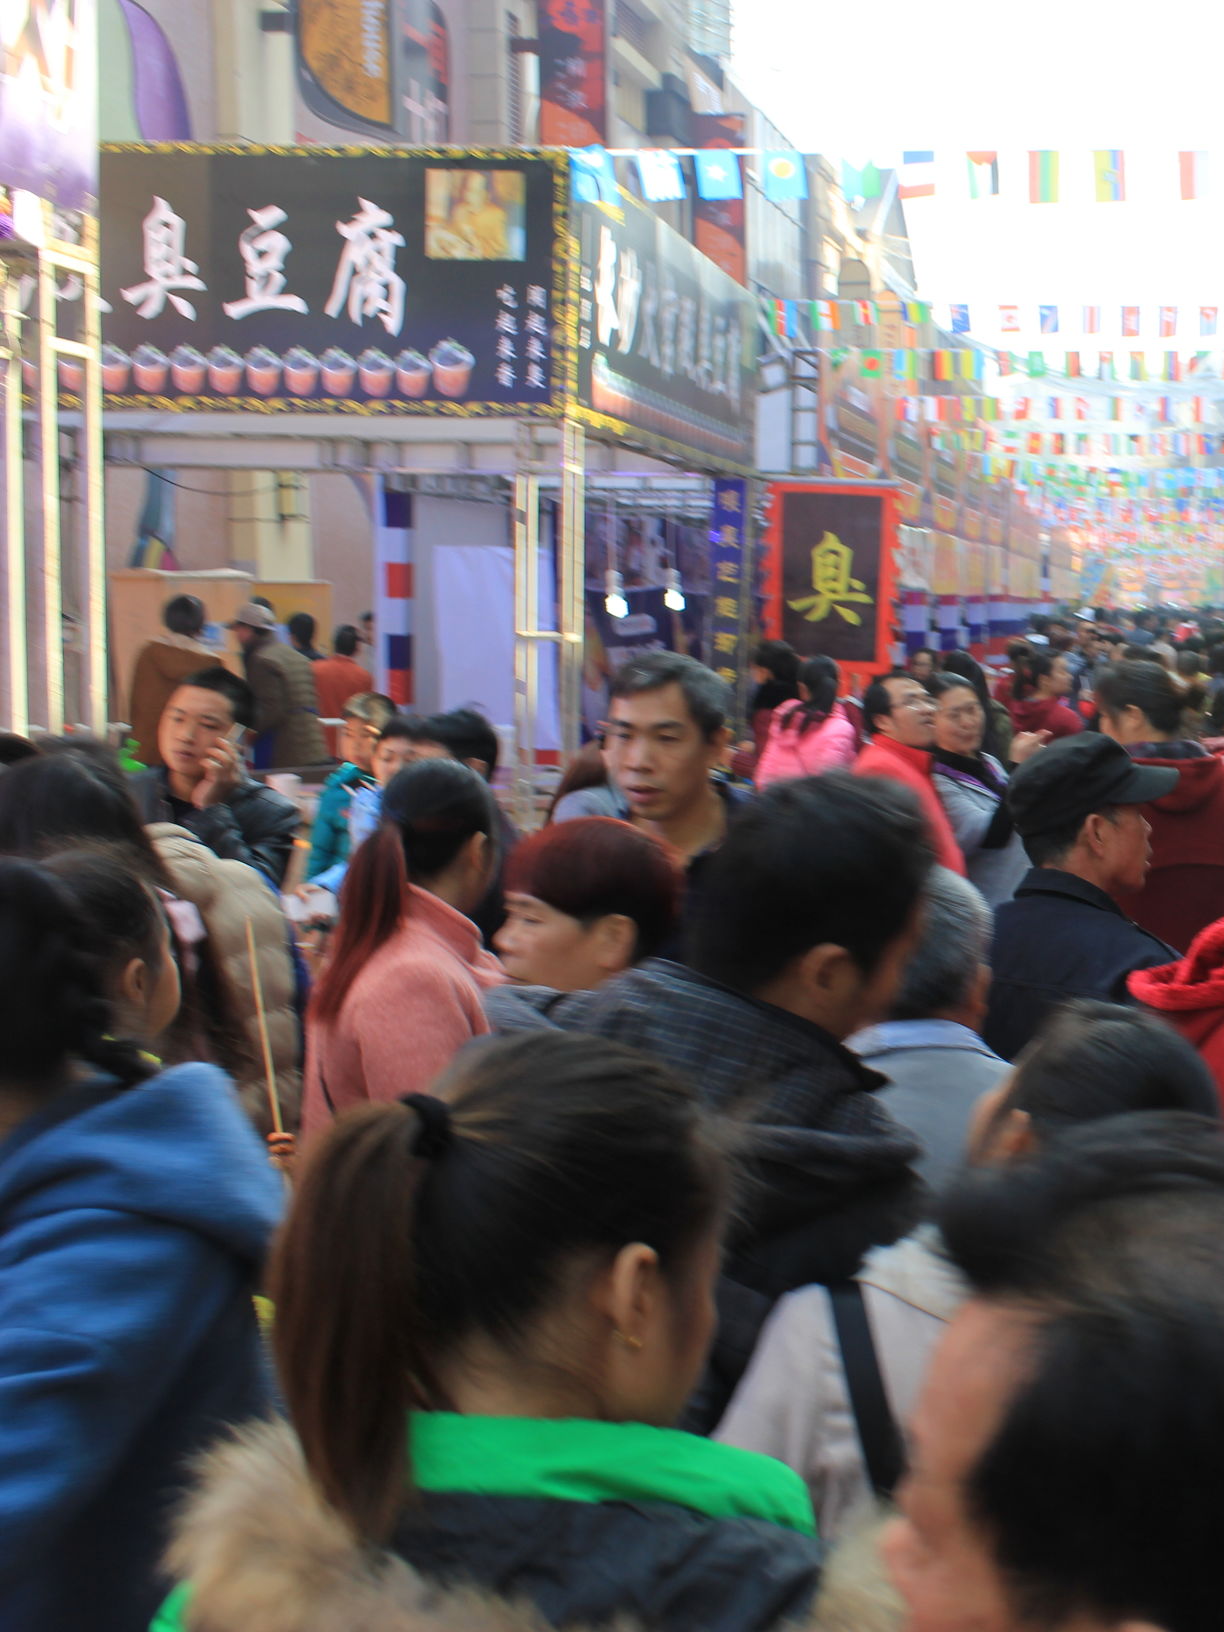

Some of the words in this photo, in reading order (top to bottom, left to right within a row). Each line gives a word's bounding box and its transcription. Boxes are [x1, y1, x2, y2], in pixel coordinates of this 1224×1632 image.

[120, 194, 408, 338] 臭豆腐
[786, 529, 875, 627] 臭
